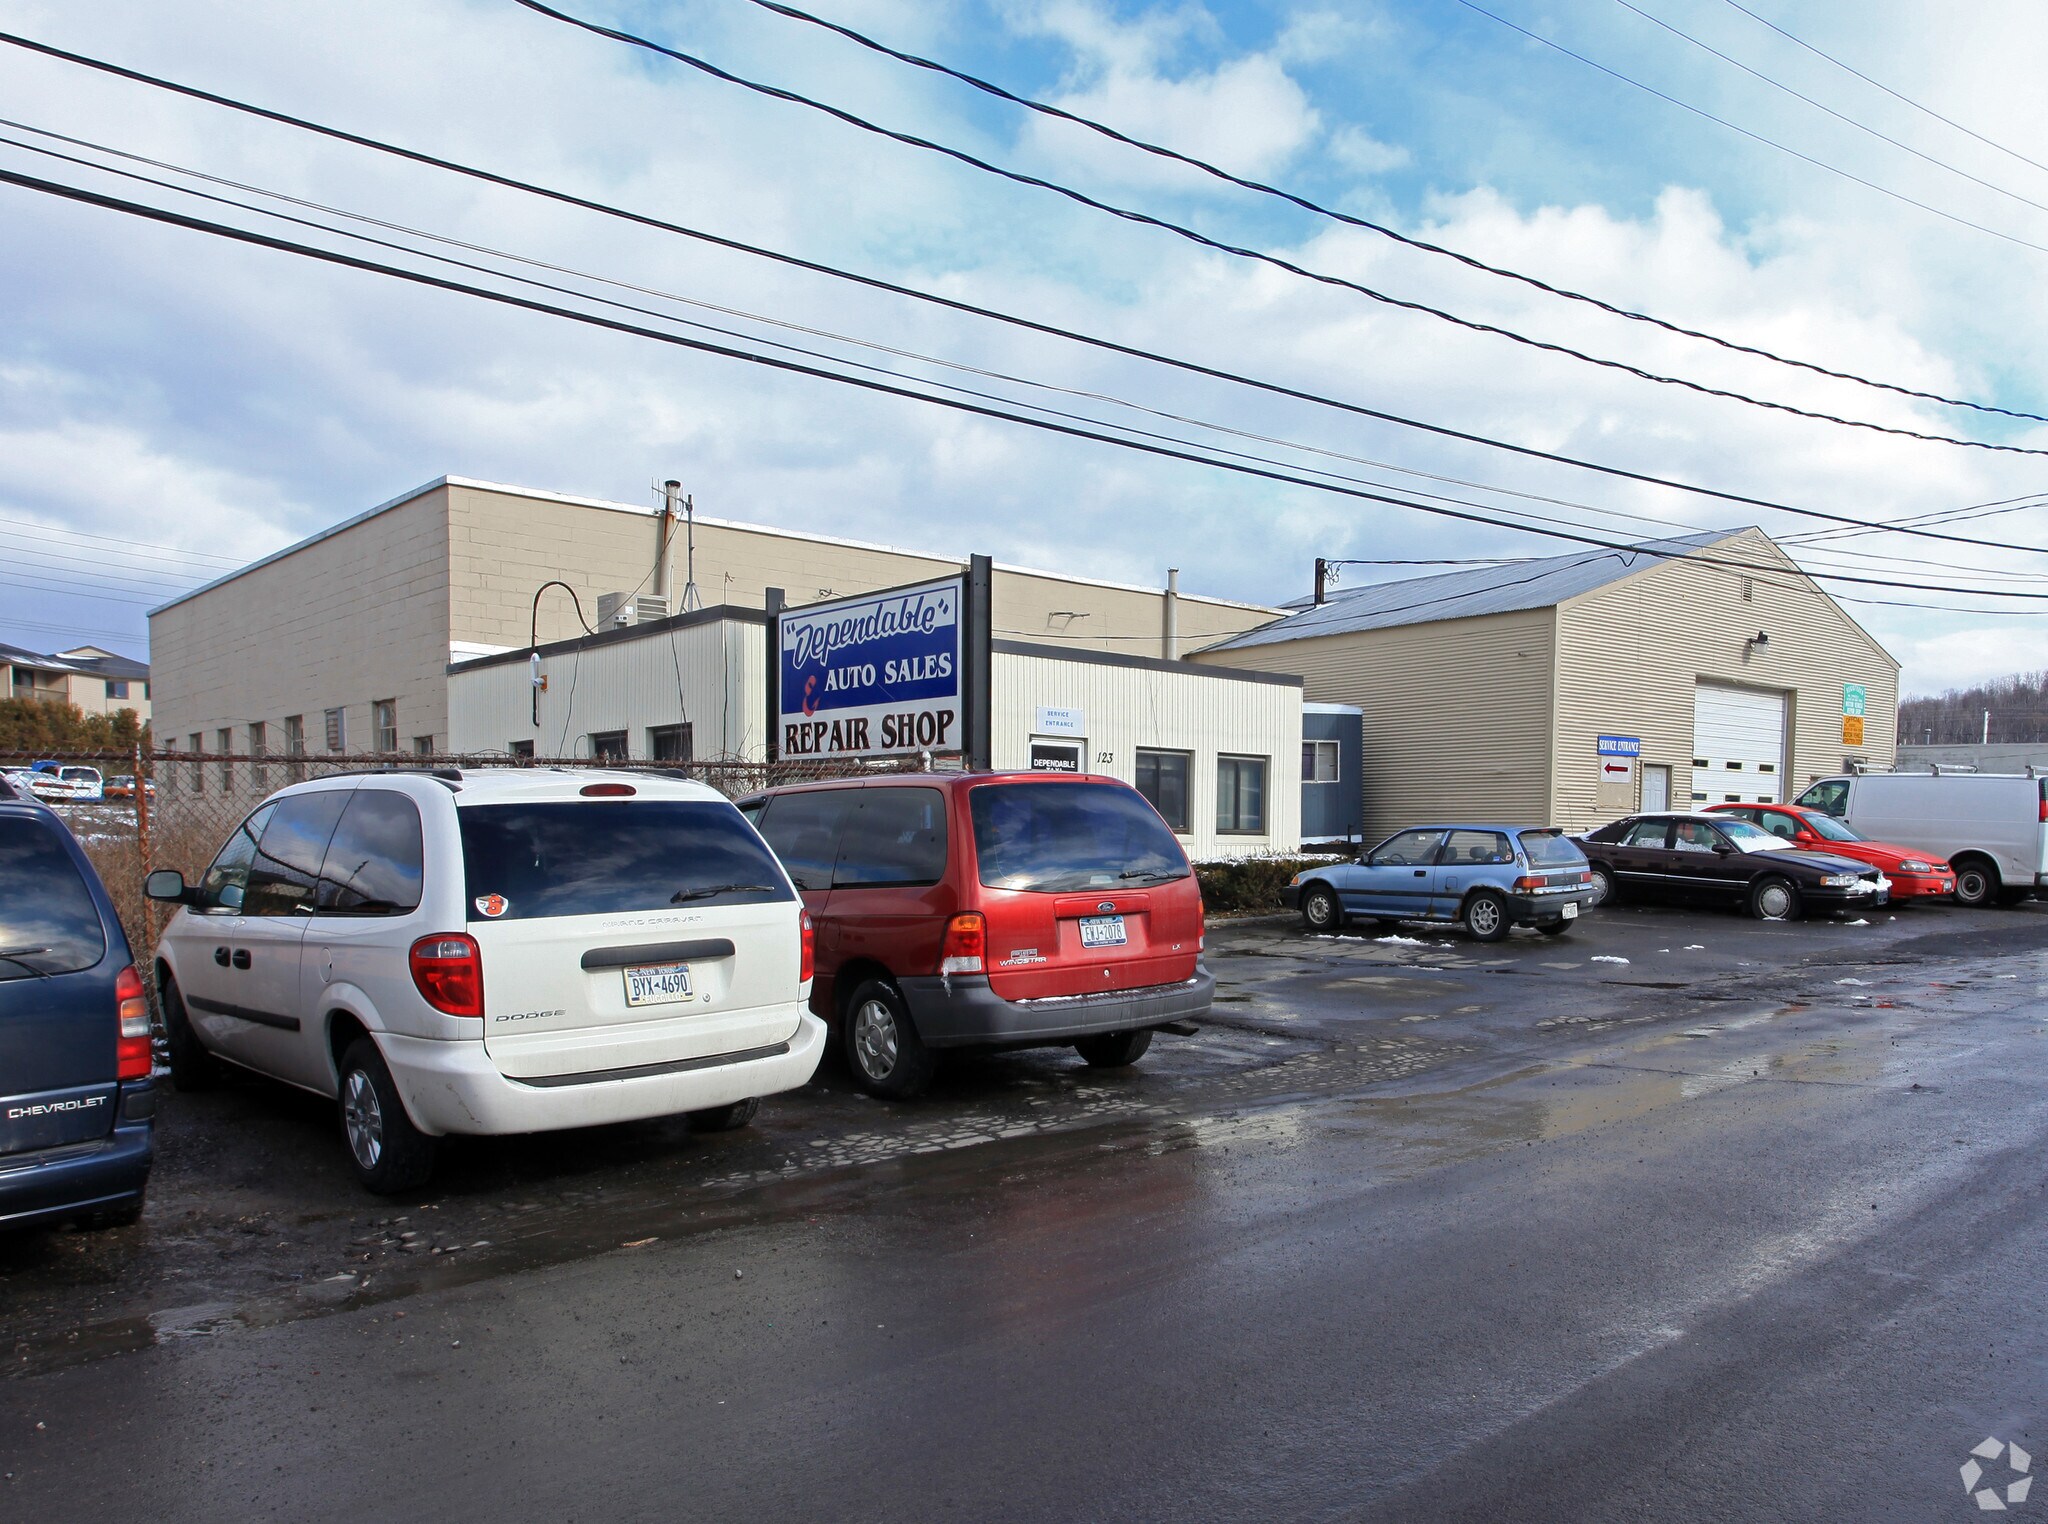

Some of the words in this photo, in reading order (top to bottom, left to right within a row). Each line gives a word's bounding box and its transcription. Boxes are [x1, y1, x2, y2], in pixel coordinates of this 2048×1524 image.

[824, 663, 876, 692] AUTO
[884, 652, 953, 685] SALES
[1047, 710, 1069, 718] SERVICE
[1045, 720, 1074, 728] ENTRANCE
[784, 717, 871, 755] REPAIR
[881, 709, 955, 749] SHOP
[1599, 739, 1617, 751] SERVICE
[1617, 740, 1639, 753] ENTRANCE
[1033, 758, 1075, 768] DEPENDABLE
[1097, 751, 1114, 764] 123
[999, 956, 1048, 967] WINDSTAR
[632, 976, 654, 996] BYX
[661, 973, 688, 993] 4690
[495, 1009, 567, 1022] DODGE
[8, 1095, 108, 1119] CHEVROLET
